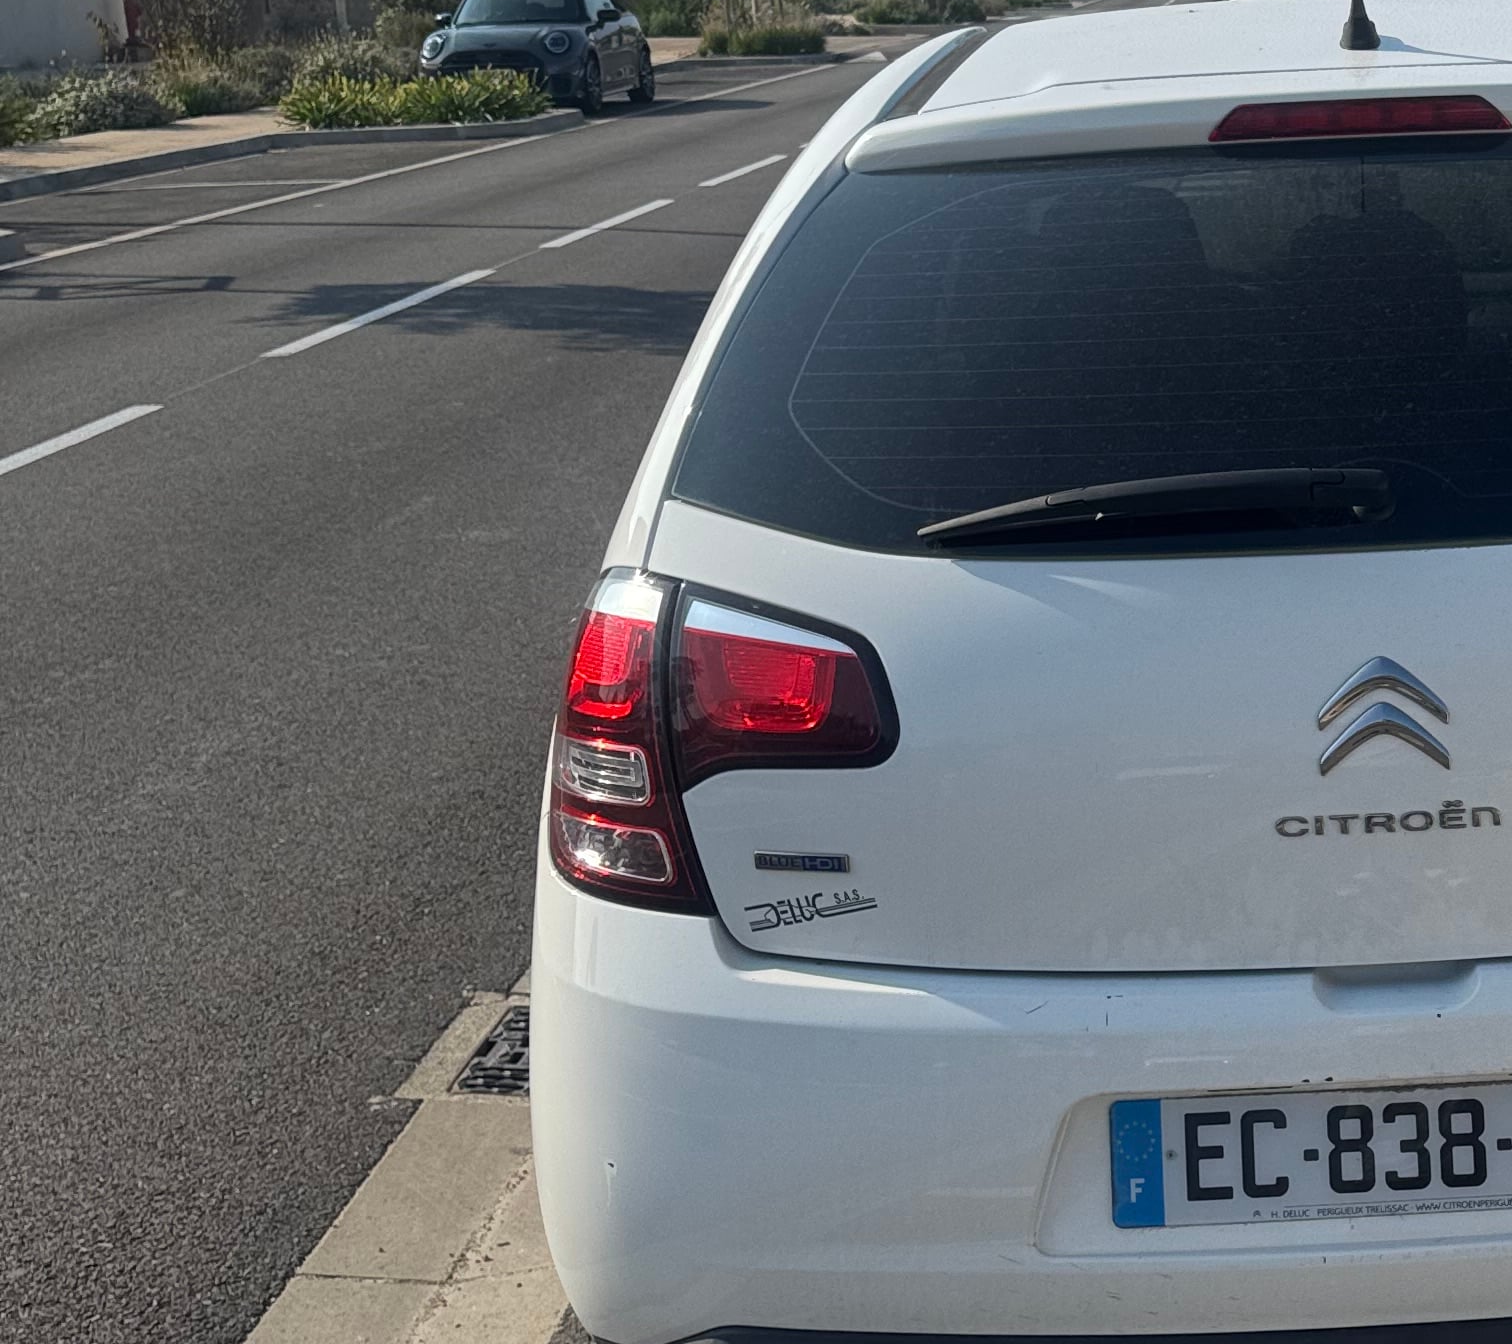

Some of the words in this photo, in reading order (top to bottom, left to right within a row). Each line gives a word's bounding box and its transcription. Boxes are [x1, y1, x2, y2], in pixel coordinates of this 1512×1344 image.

[1275, 800, 1501, 837] CITROËN
[1130, 1178, 1145, 1203] F
[1283, 1208, 1311, 1219] DELUC
